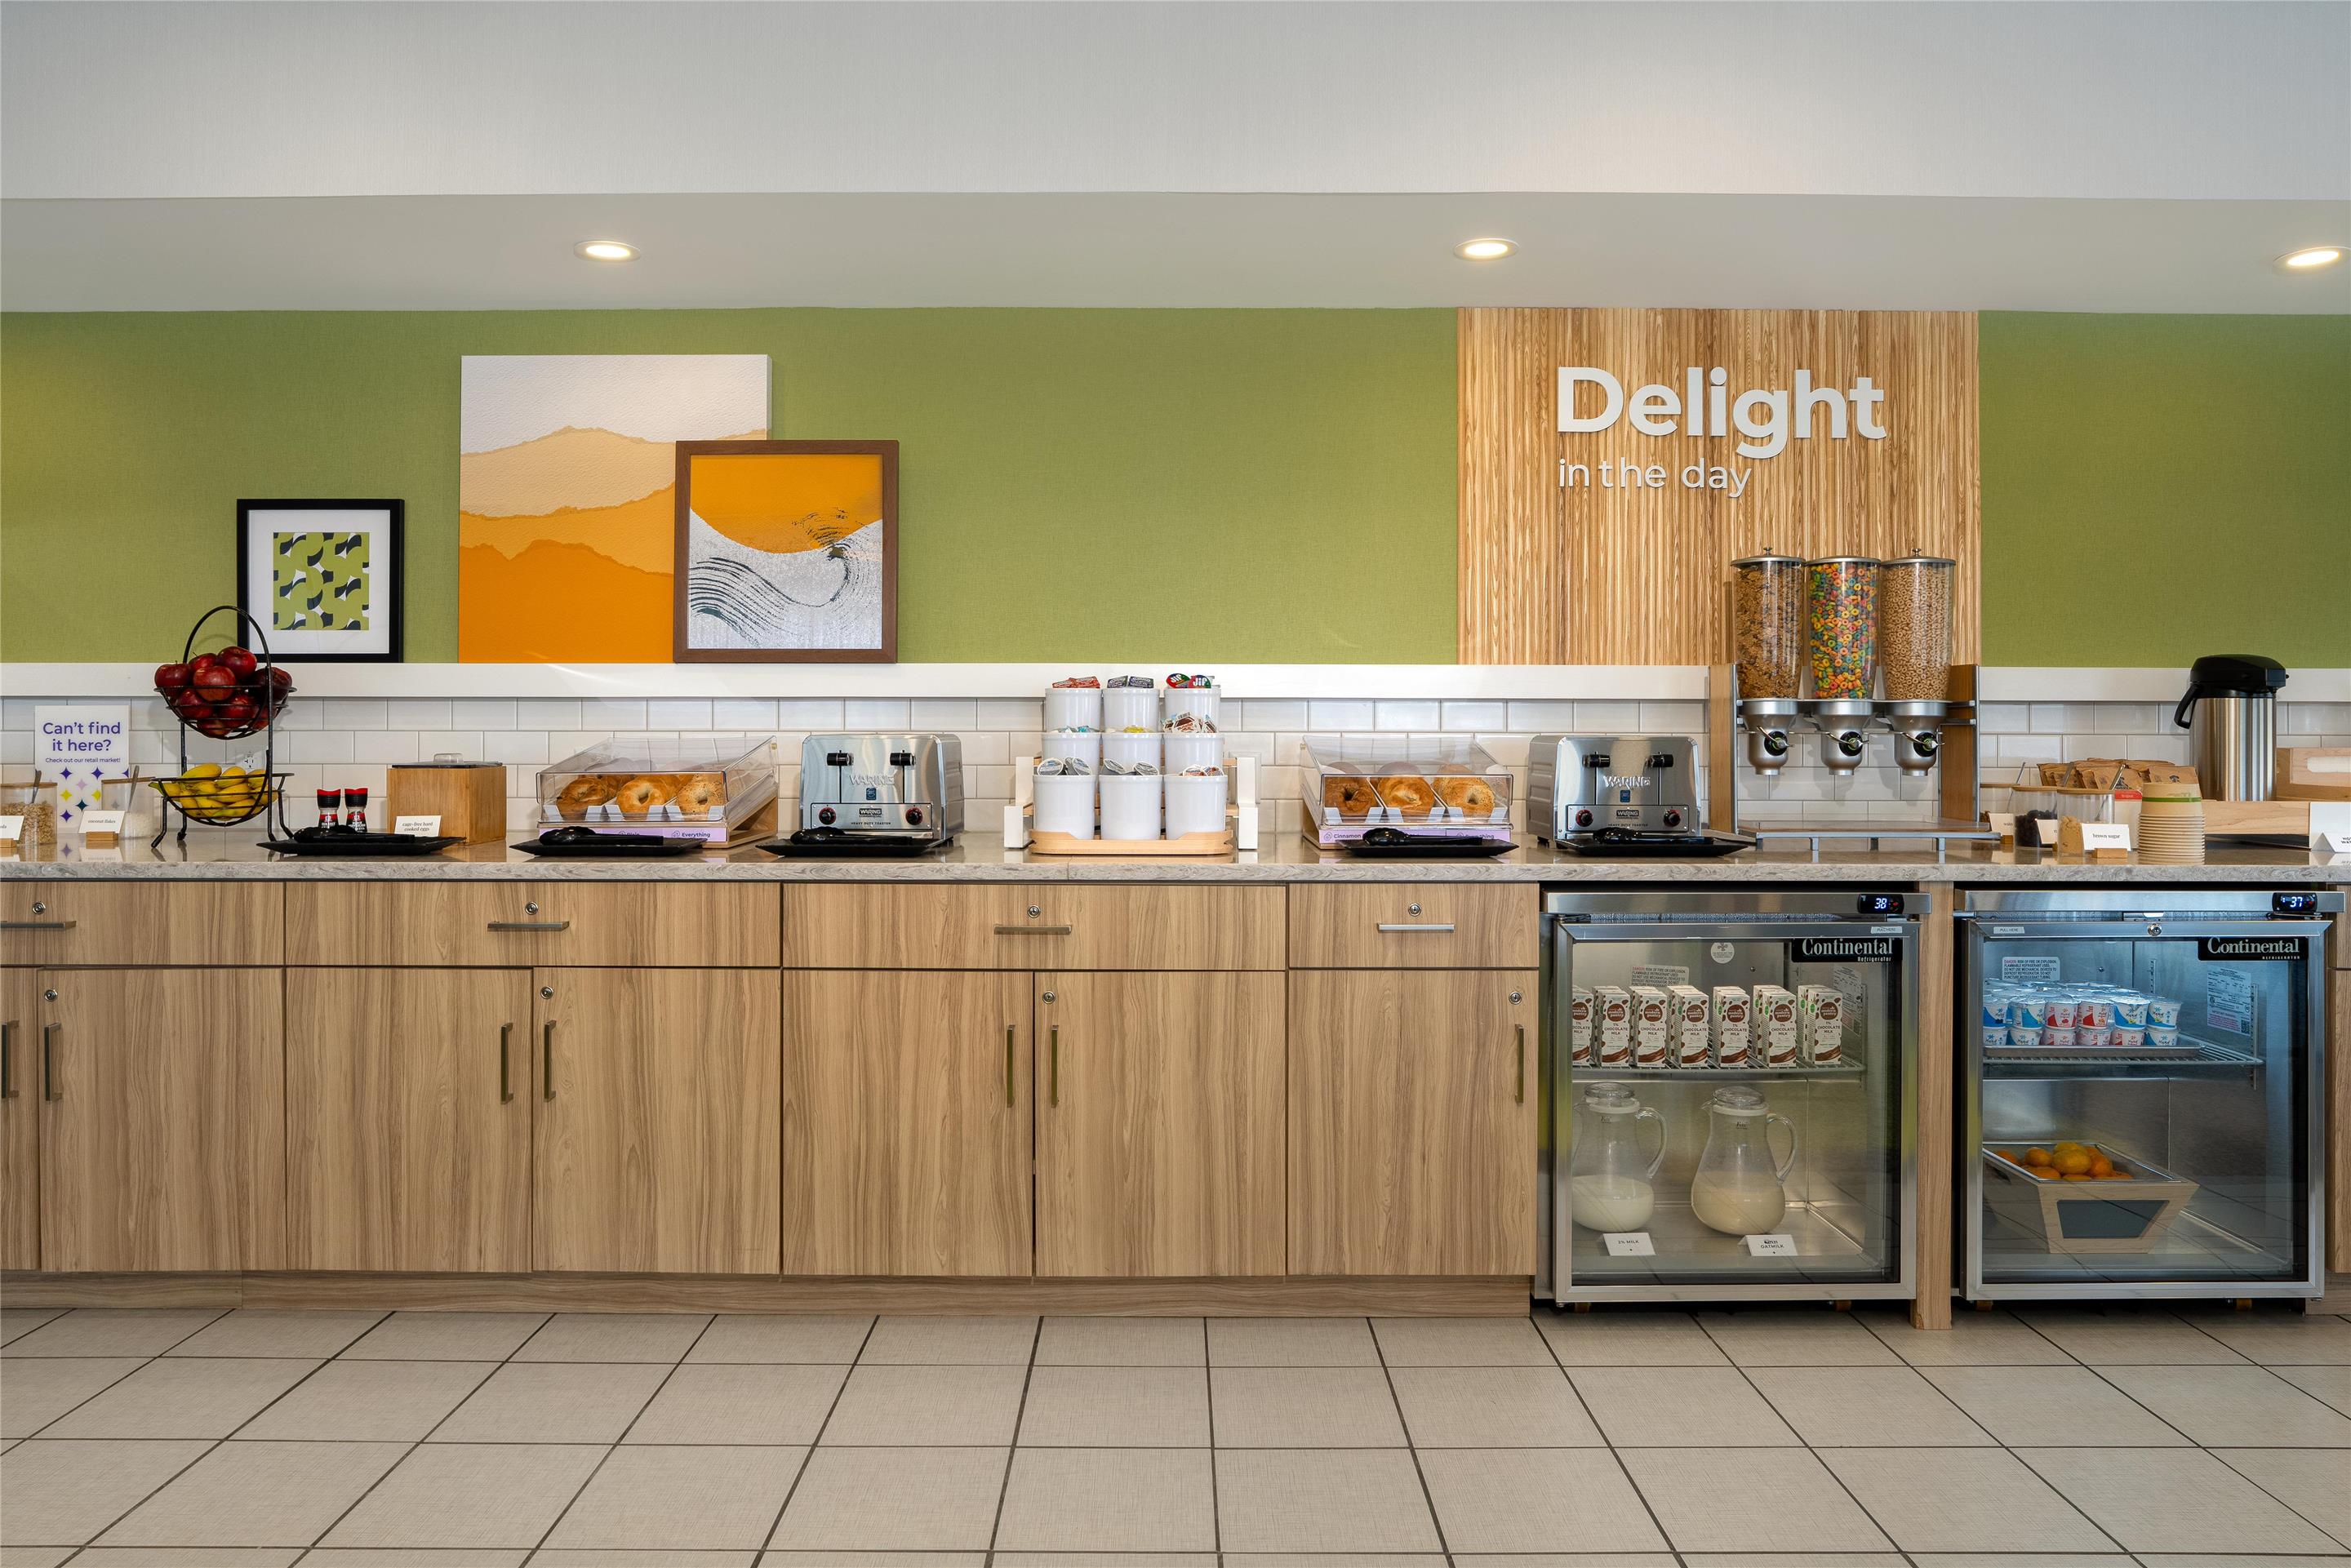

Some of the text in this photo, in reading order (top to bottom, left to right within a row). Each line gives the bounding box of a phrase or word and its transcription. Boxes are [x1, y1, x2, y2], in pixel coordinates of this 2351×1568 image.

[1557, 366, 1887, 460] Delight
[1558, 456, 1752, 499] in the day
[43, 722, 121, 735] Can't find
[52, 739, 112, 751] it here?
[1603, 775, 1651, 789] WARING
[1874, 897, 1887, 909] 38
[2290, 896, 2303, 908] 37
[1802, 938, 1893, 956] Continental
[2207, 936, 2300, 954] Continental
